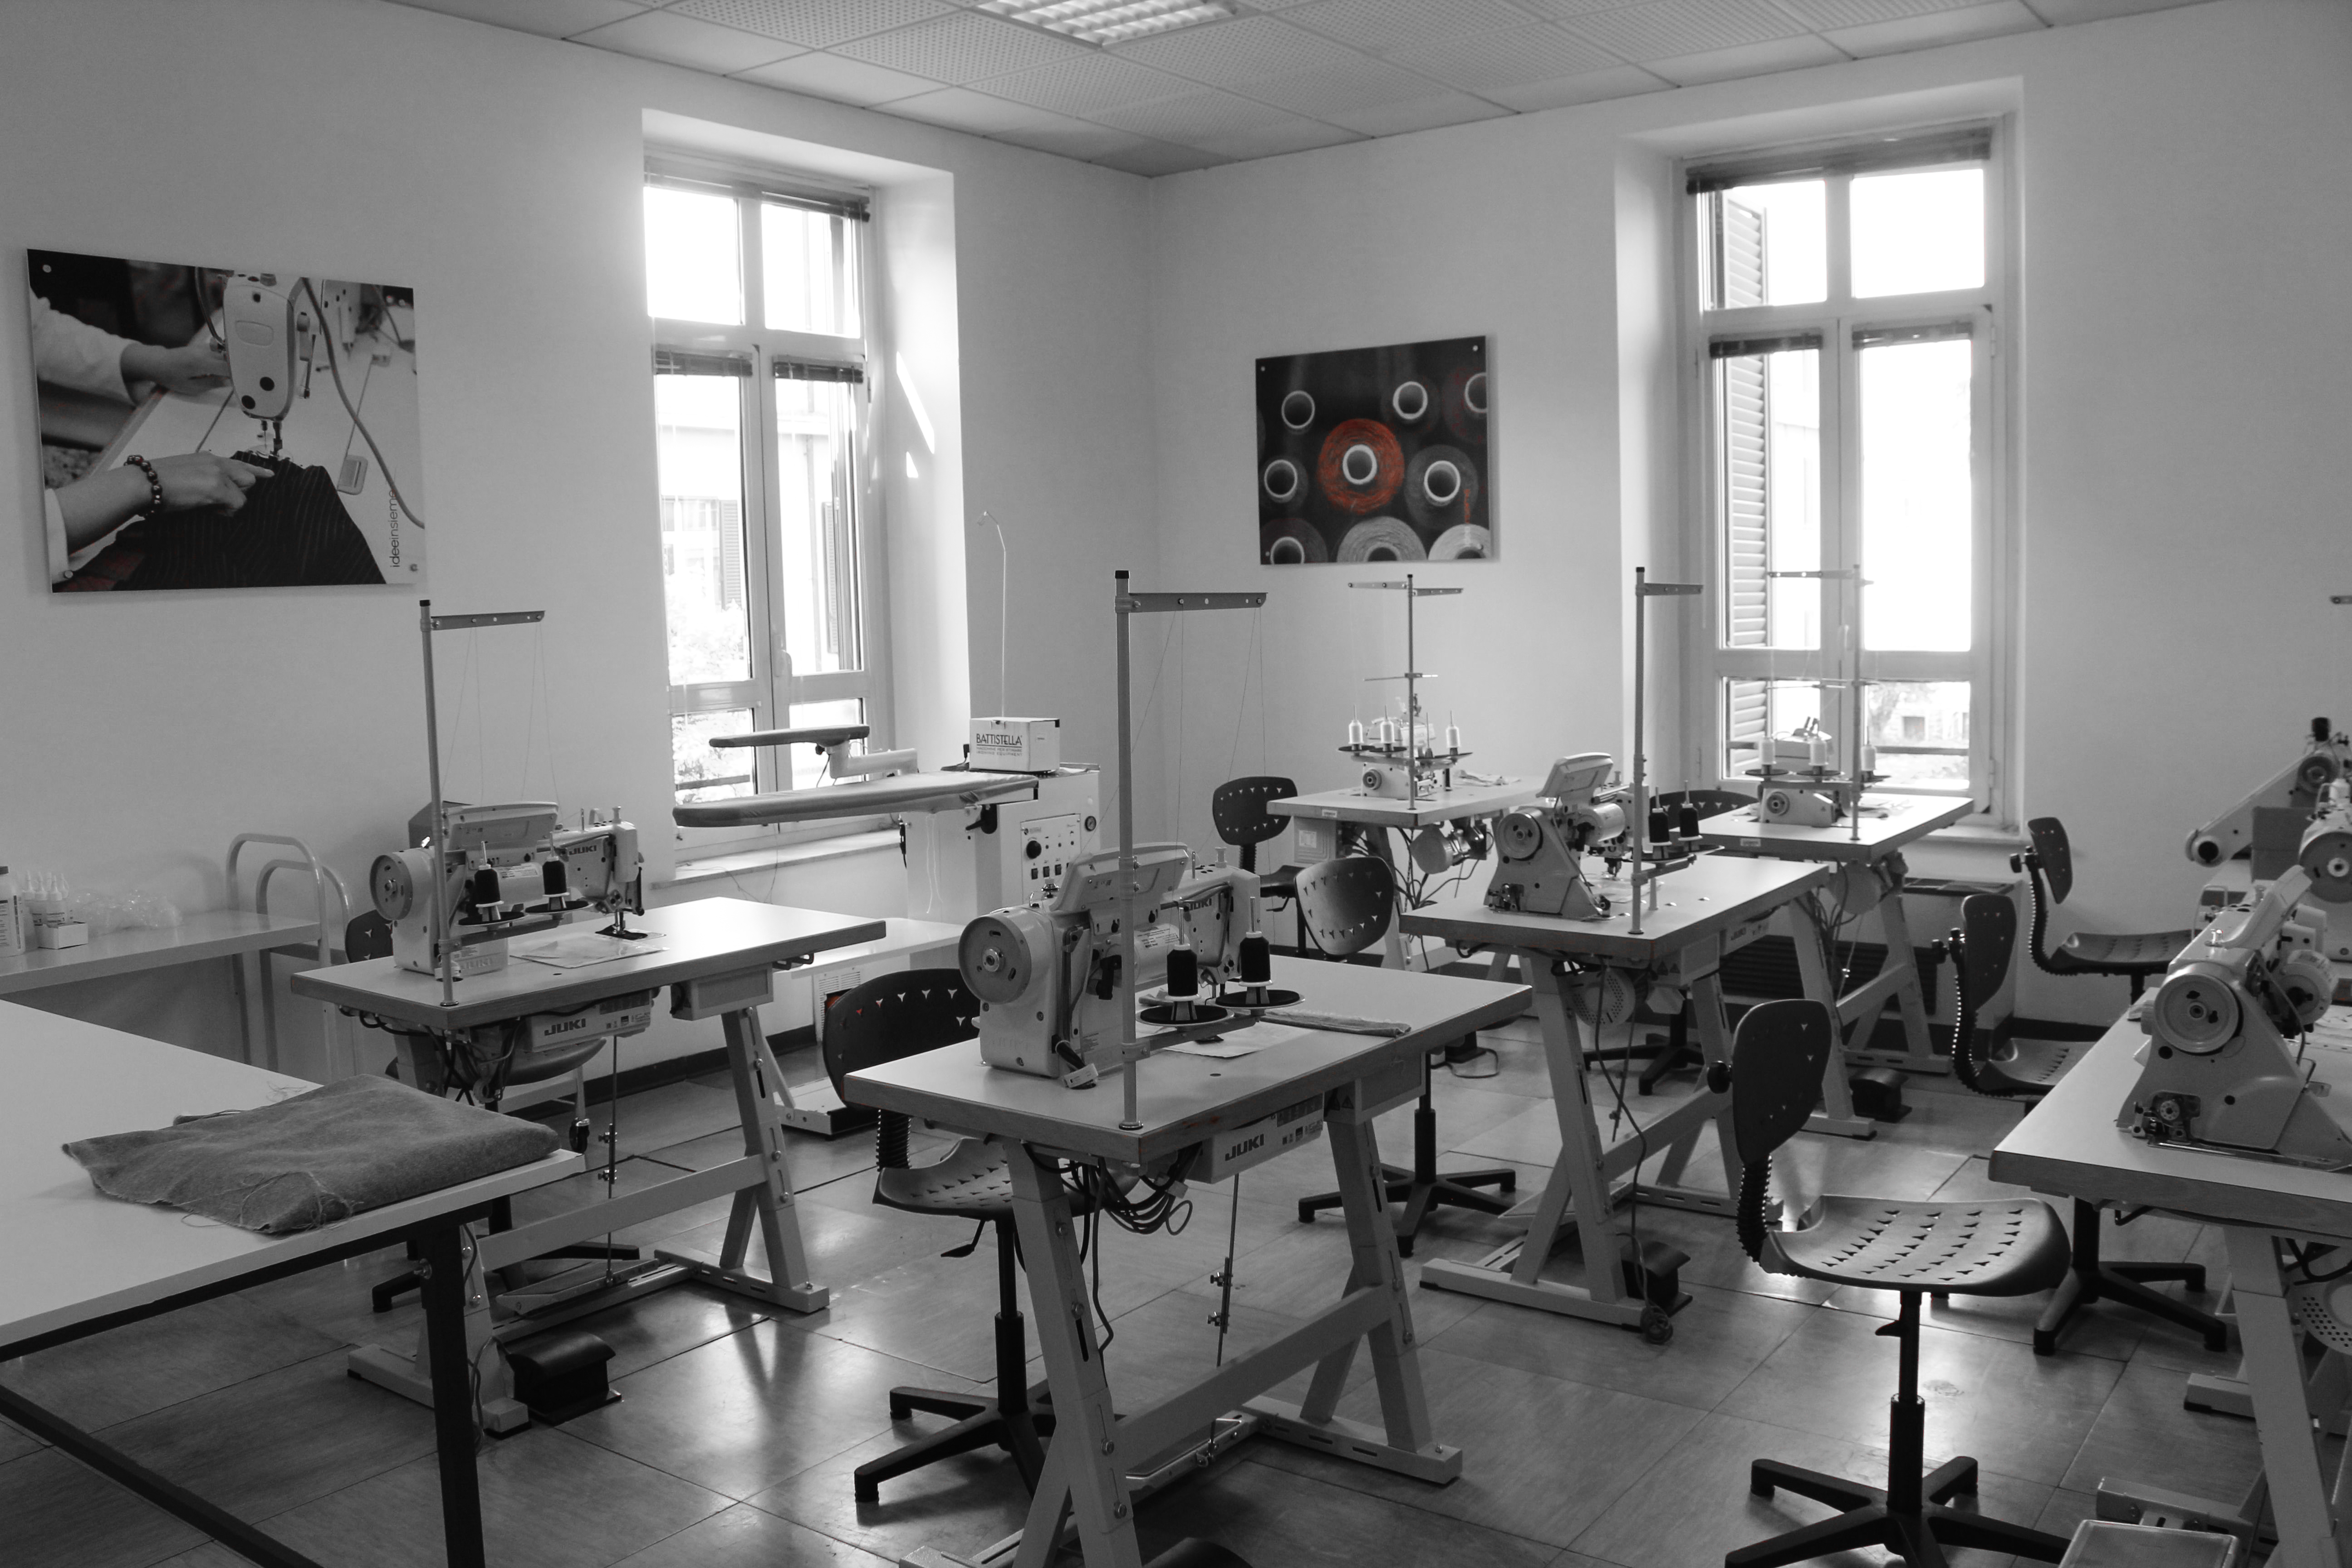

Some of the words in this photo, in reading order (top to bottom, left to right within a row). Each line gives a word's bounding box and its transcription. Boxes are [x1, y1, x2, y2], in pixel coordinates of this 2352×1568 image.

[388, 490, 400, 568] ideeinsieme
[976, 733, 1022, 745] BATTISTELLA
[569, 845, 597, 856] JUKI
[544, 1018, 586, 1036] JUKI
[1225, 1133, 1264, 1161] JUKI
